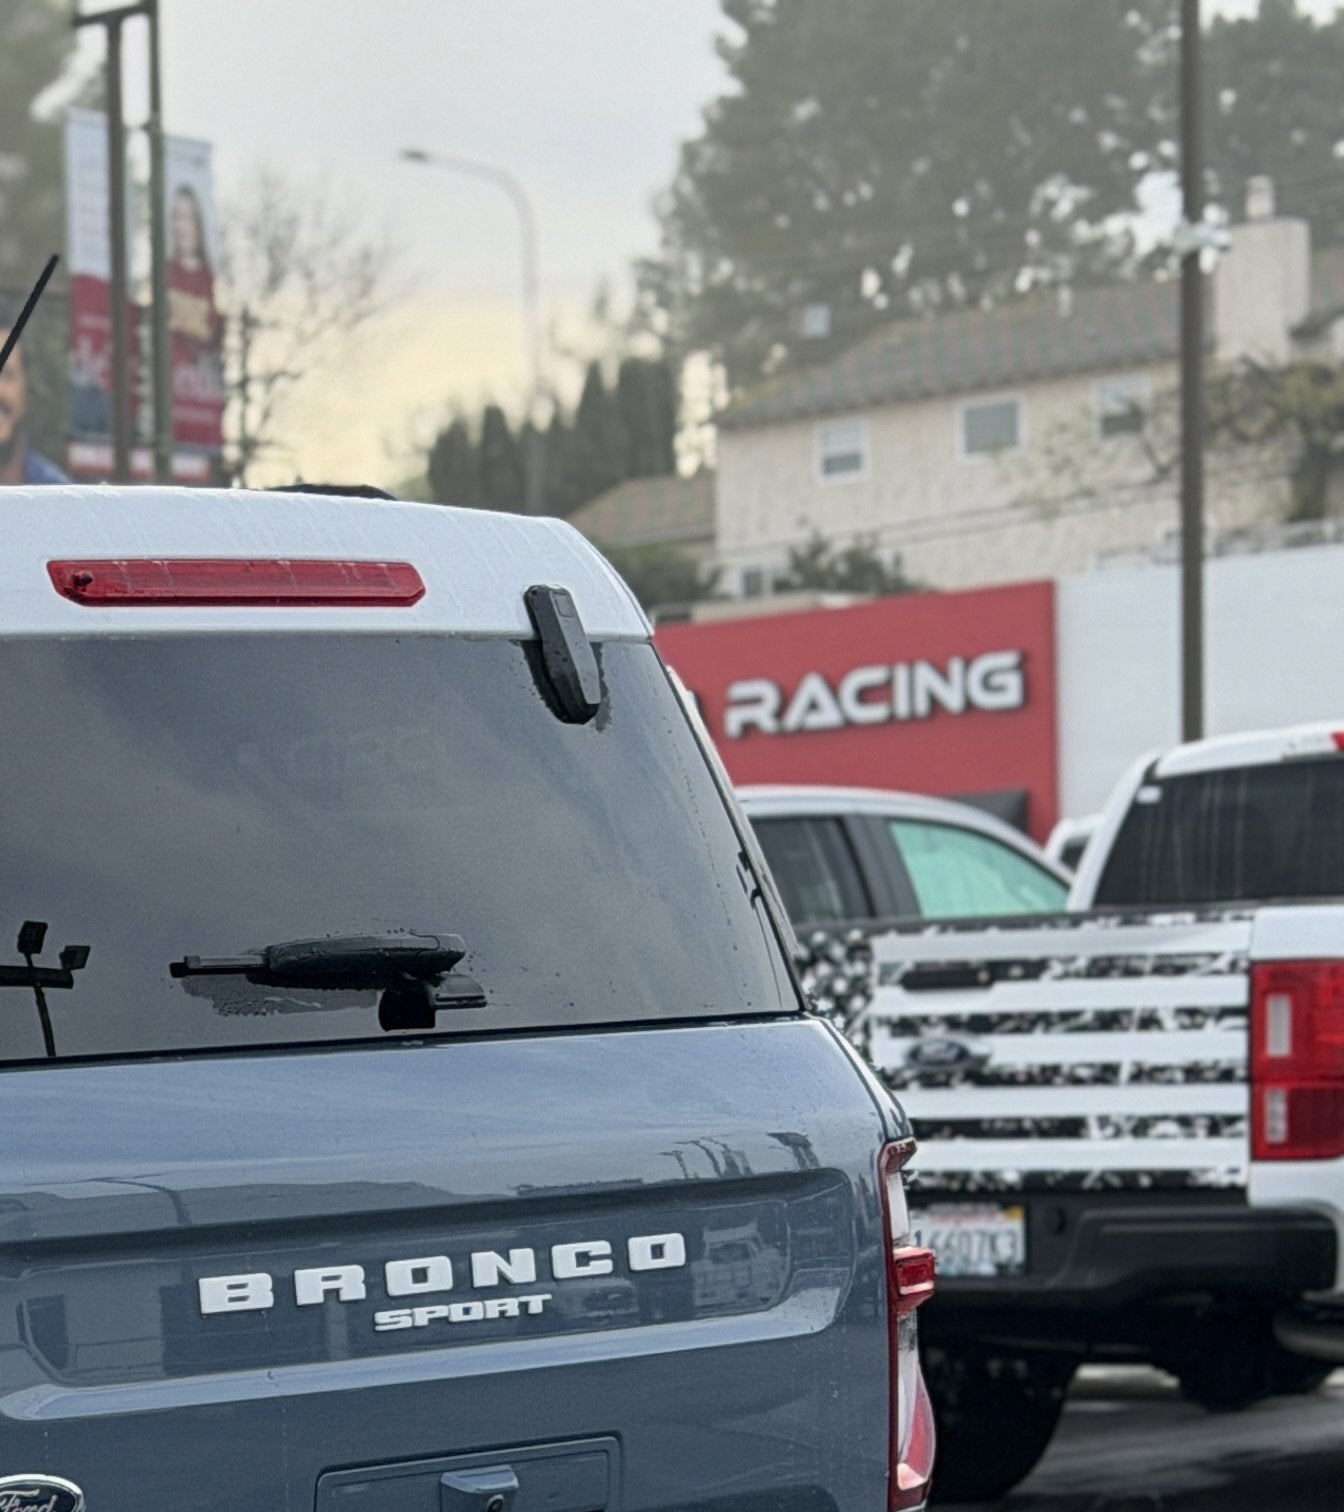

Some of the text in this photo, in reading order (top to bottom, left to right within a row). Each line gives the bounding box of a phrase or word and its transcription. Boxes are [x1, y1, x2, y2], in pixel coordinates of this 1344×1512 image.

[724, 649, 1025, 739] RACING
[198, 1232, 686, 1314] BRONCO
[374, 1293, 552, 1331] SPORT
